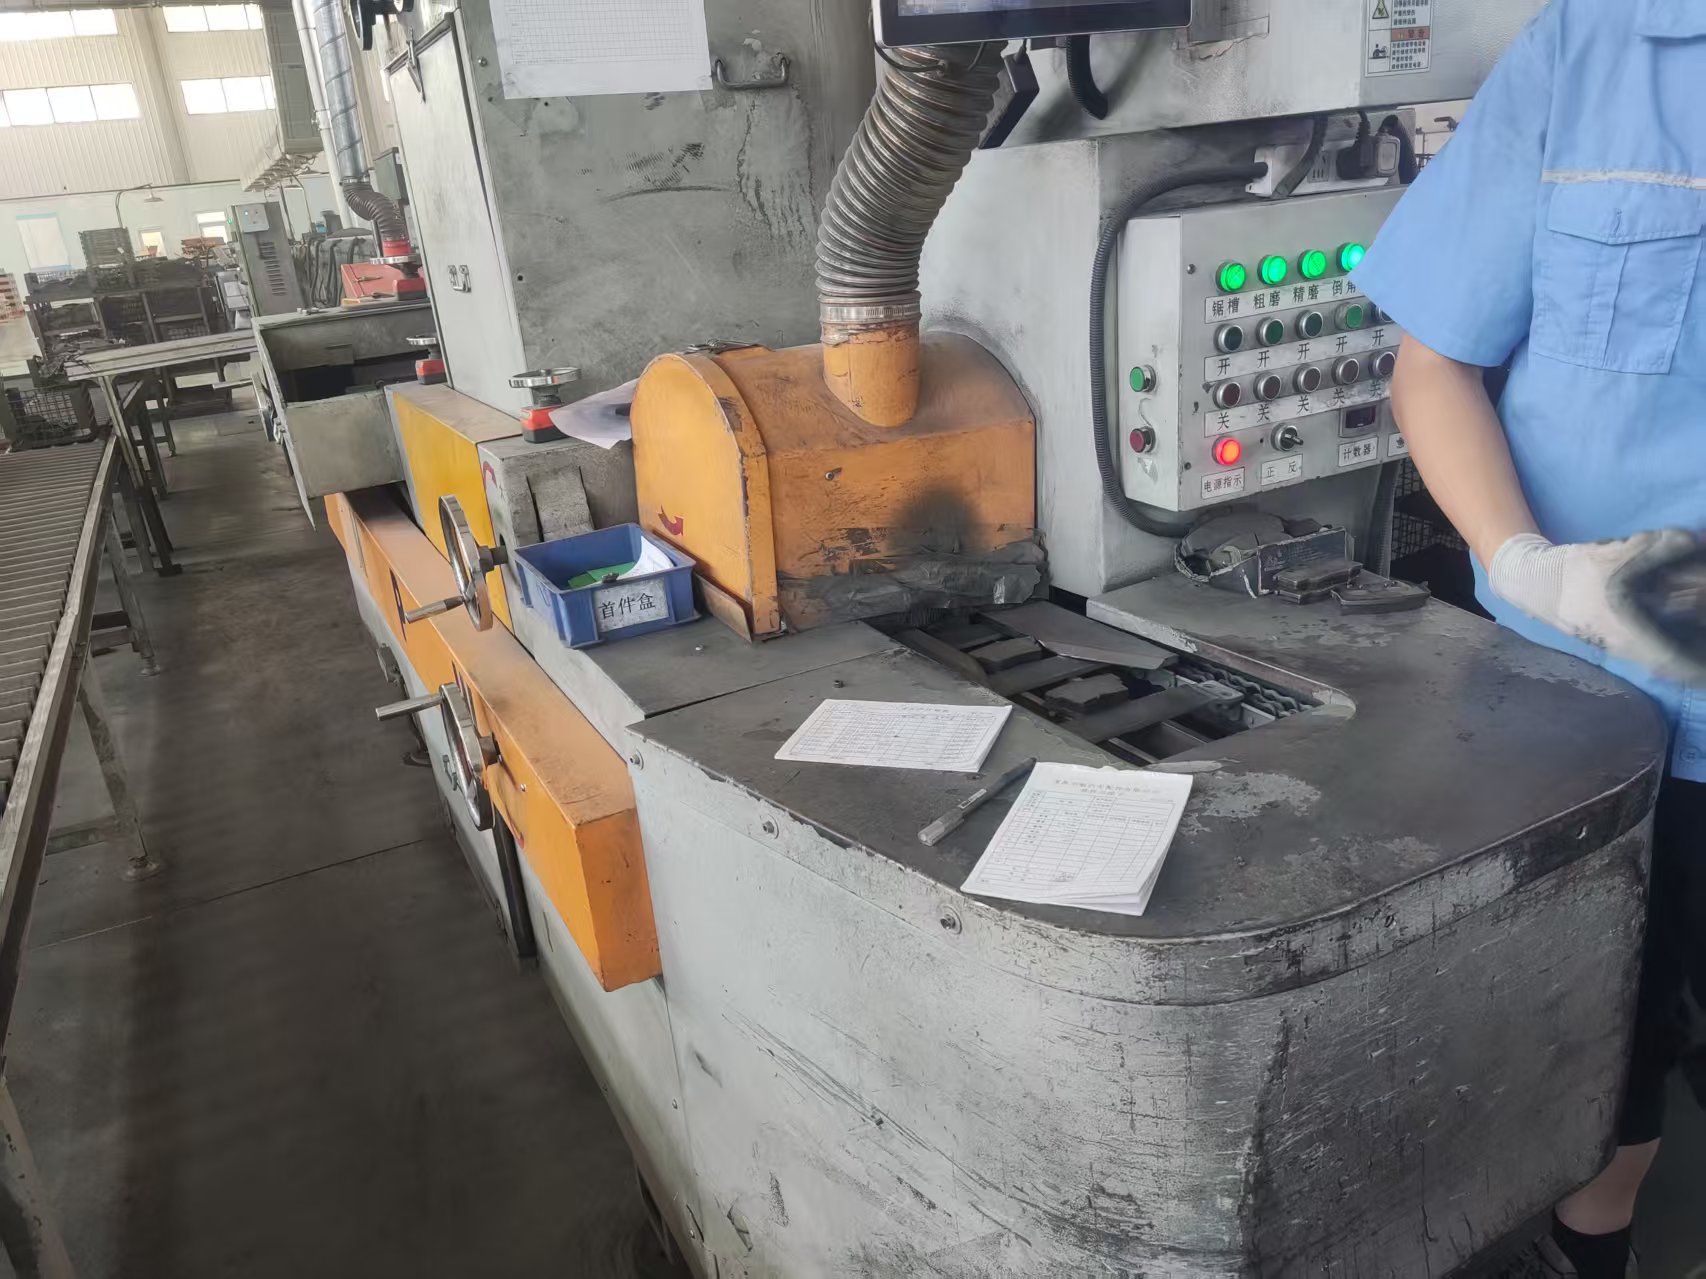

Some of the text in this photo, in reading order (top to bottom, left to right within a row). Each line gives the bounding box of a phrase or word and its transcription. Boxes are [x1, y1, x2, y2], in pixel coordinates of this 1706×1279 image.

[1211, 297, 1240, 318] 锯槽
[1253, 290, 1281, 309] 粗磨
[1292, 284, 1320, 303] 精磨
[1217, 328, 1385, 376] 开 开 开 开 开
[1217, 380, 1383, 431] 关 关 关 关 关
[1342, 442, 1372, 461] 计数器
[1266, 460, 1298, 478] 正 反
[1203, 474, 1244, 493] 电源指示
[598, 592, 656, 619] 首件盒
